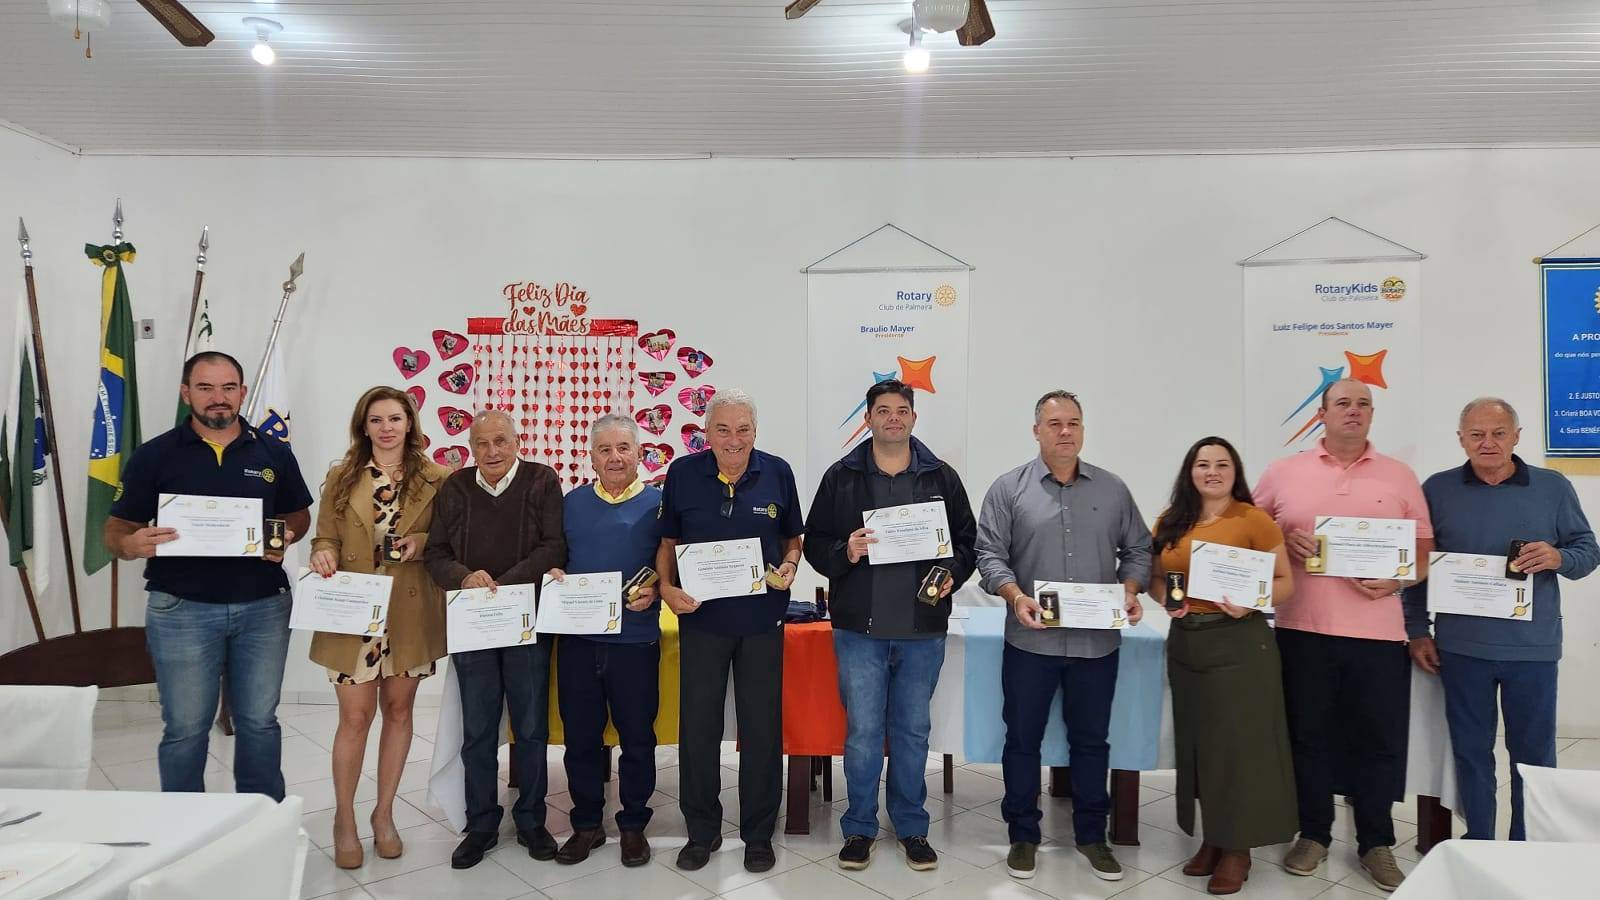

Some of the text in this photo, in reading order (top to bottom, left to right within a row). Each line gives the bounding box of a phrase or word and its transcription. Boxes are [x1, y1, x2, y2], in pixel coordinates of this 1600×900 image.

[1315, 283, 1378, 295] RotaryKids
[503, 282, 590, 311] Feliz Dia
[896, 291, 932, 302] Rotary
[905, 303, 932, 311] Palmeira
[505, 309, 587, 334] das Mães
[1293, 324, 1318, 332] Felipe
[1336, 322, 1365, 330] Santos
[1366, 321, 1393, 330] Mayer
[860, 325, 915, 333] Braulio Mayer
[1572, 333, 1600, 341] A PRO
